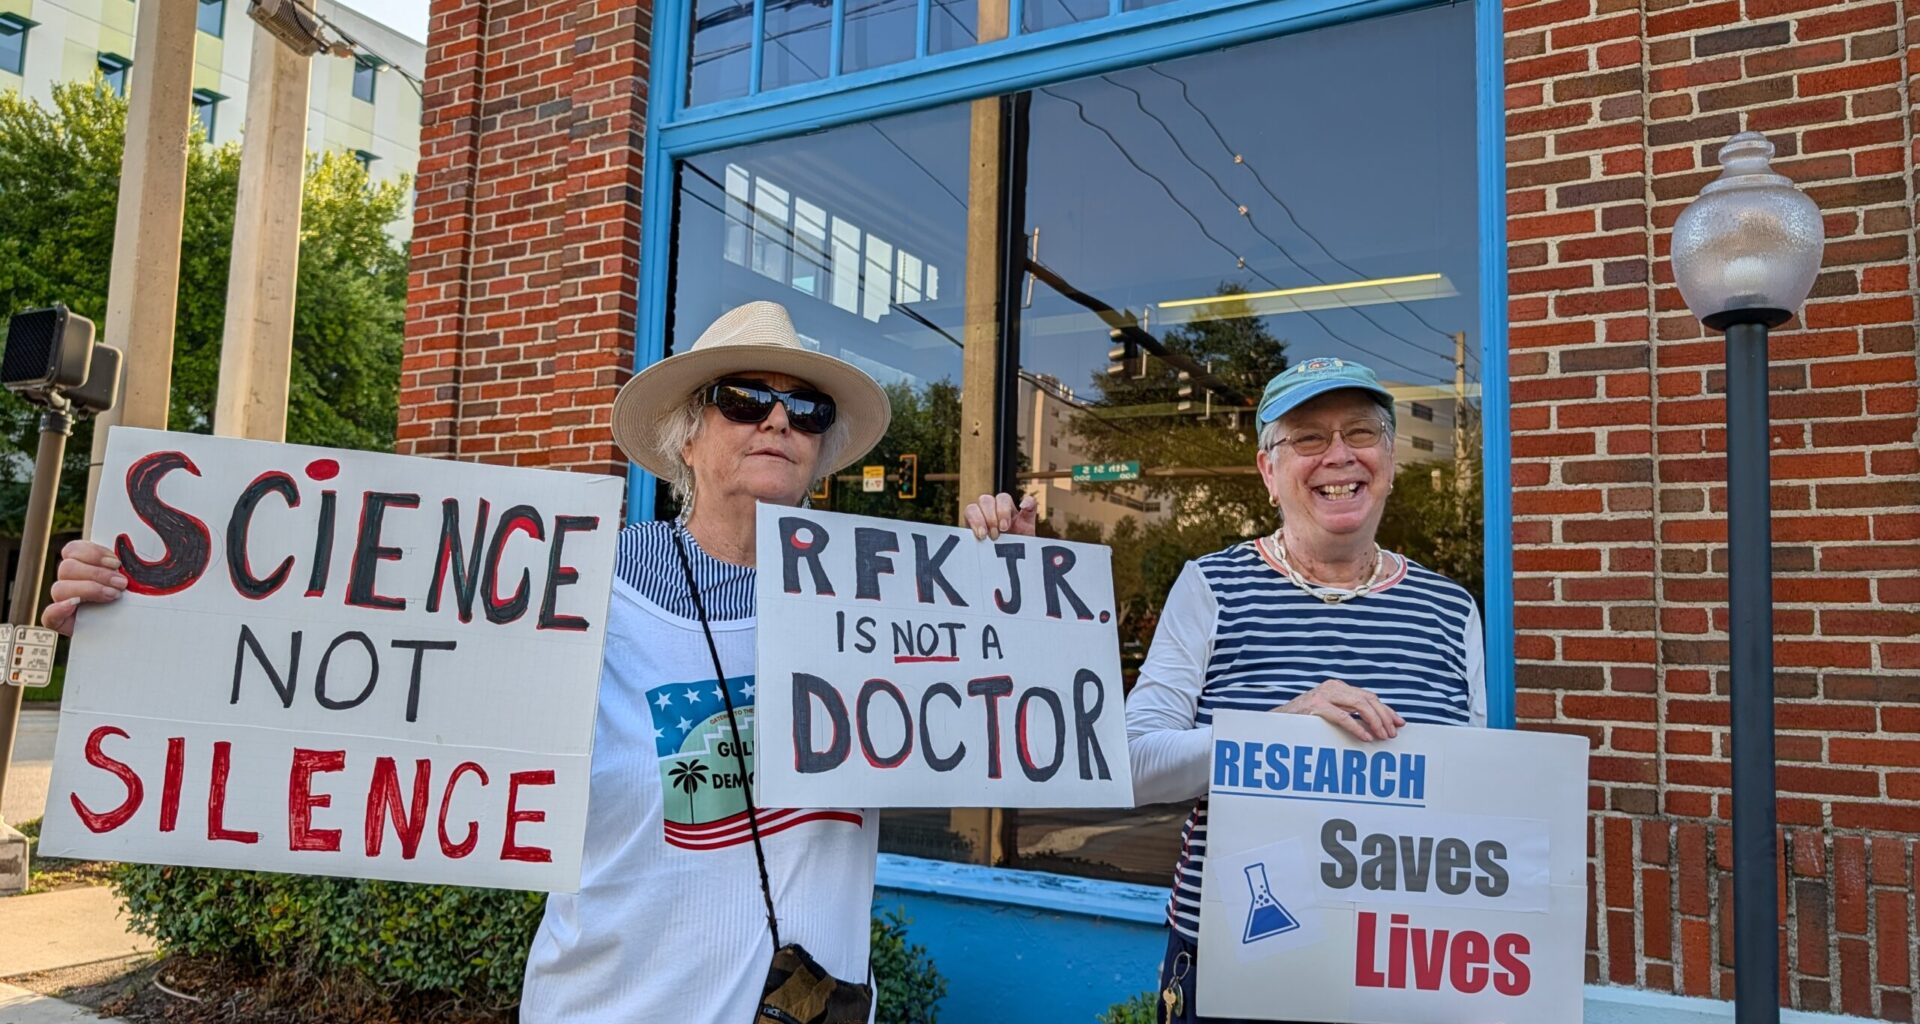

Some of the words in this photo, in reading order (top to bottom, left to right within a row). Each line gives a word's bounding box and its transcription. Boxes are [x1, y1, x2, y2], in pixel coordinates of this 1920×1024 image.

[778, 516, 969, 607] RFK
[994, 542, 1111, 624] JR.
[230, 624, 457, 722] NOT
[836, 610, 877, 653] IS
[891, 619, 966, 658] NOT
[982, 624, 1004, 660] A
[718, 741, 754, 757] GUL
[791, 668, 1113, 782] DOCTOR
[70, 725, 556, 863] SILENCE
[1213, 739, 1426, 800] RESEARCH
[1320, 818, 1510, 898] Saves
[1355, 911, 1531, 997] Lives
